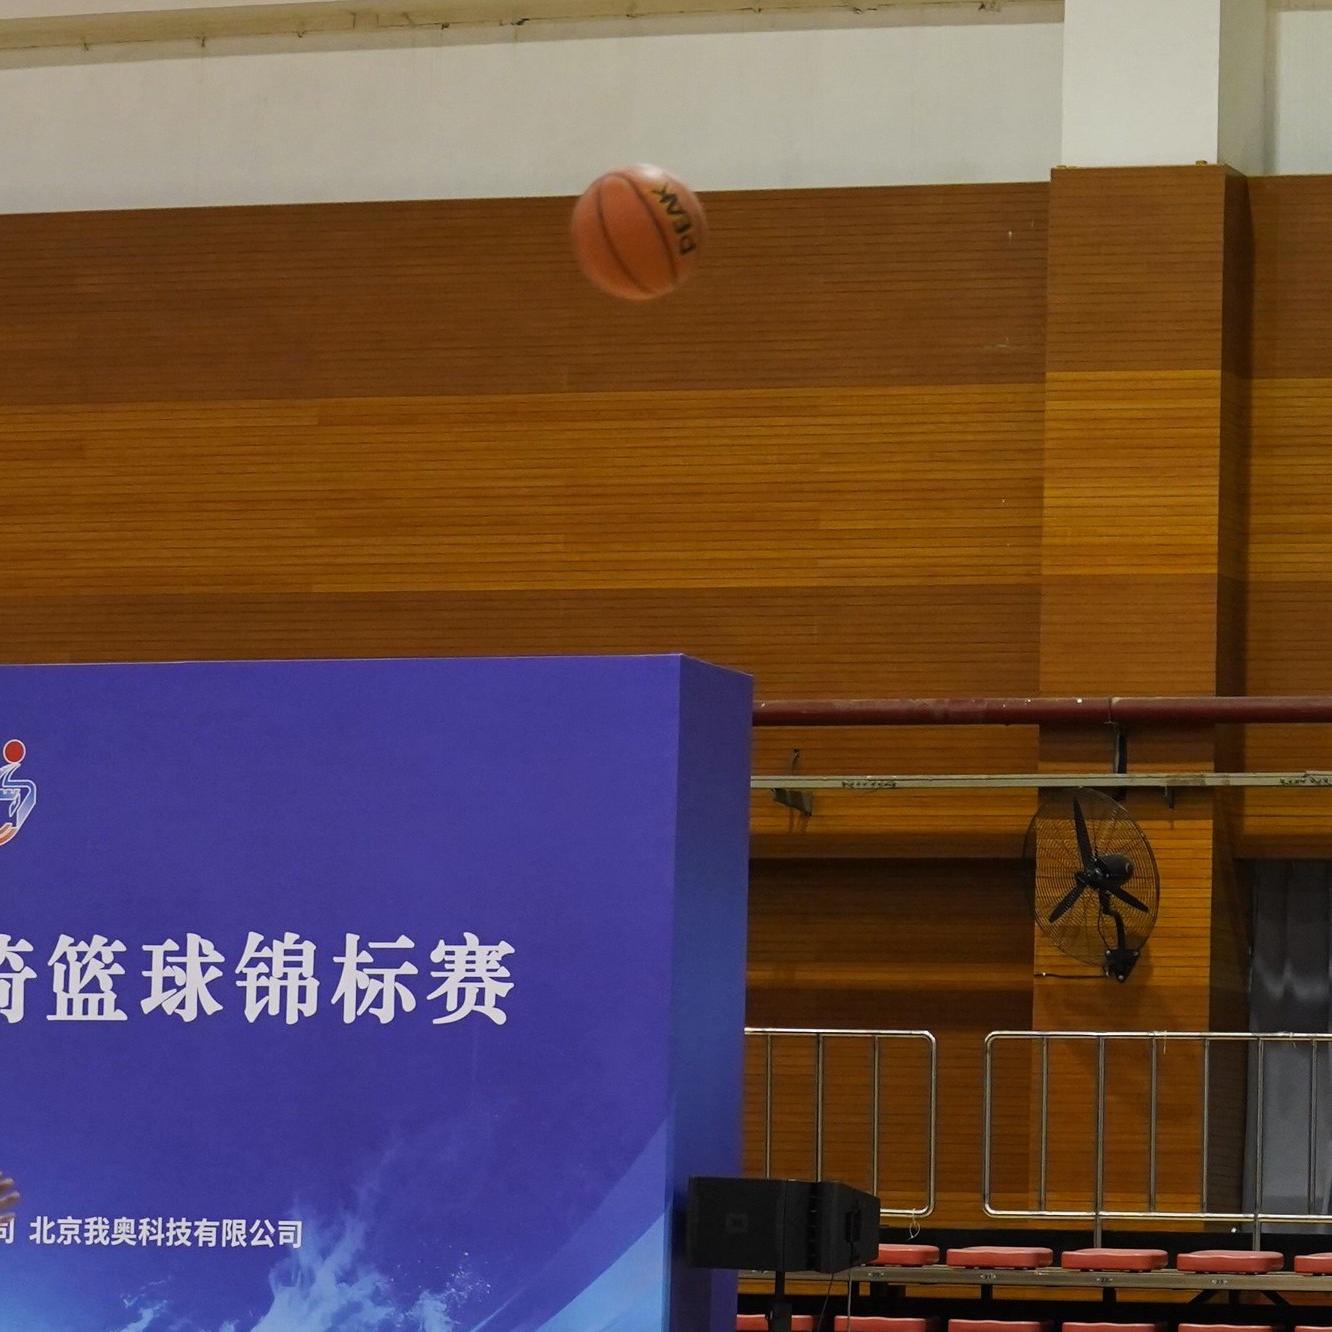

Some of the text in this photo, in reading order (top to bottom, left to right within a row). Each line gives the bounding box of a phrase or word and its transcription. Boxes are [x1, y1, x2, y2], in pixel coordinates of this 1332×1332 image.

[29, 1215, 303, 1249] 北京我奥科技有限公司
